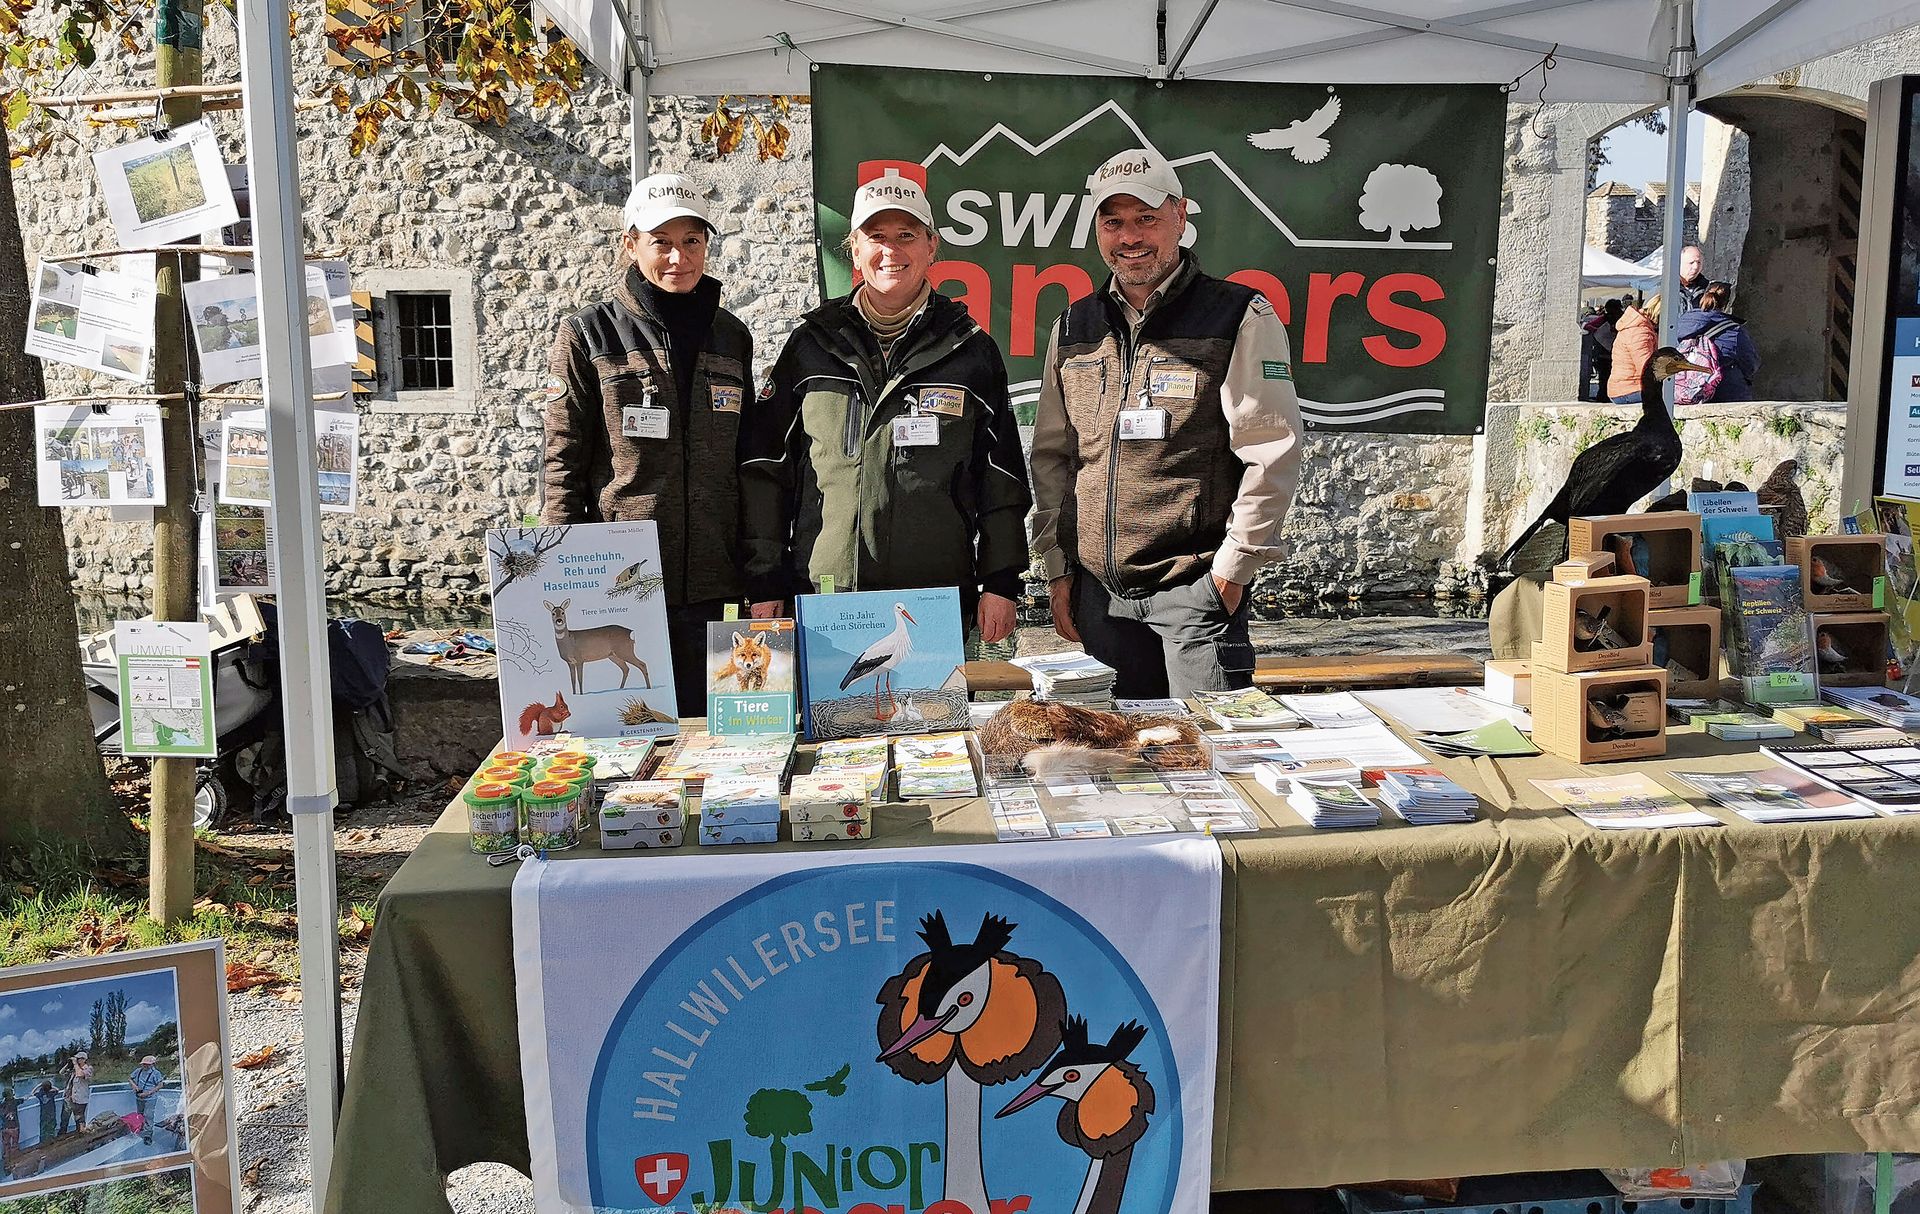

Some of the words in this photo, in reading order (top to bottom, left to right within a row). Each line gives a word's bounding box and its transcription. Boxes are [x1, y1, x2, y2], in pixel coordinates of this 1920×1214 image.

[1100, 158, 1150, 182] Ranger
[648, 186, 697, 201] Ranger
[865, 186, 917, 201] Ranger
[853, 260, 1447, 368] anrs
[1168, 383, 1194, 391] Ranger
[938, 399, 962, 409] Ranger
[1718, 505, 1748, 514] Schweiz
[627, 527, 645, 535] Müller
[557, 551, 626, 565] Schneehuhn,
[564, 566, 584, 577] Reh
[587, 564, 607, 576] und
[543, 579, 600, 592] Haselmaus
[1742, 600, 1772, 609] Reptilien
[581, 608, 598, 616] Tiere
[599, 607, 607, 615] im
[608, 606, 629, 614] Winter
[839, 612, 855, 621] Ein
[856, 611, 876, 620] Jahr
[1742, 608, 1755, 616] der
[1755, 607, 1782, 616] Schweiz
[814, 623, 830, 632] mit
[830, 622, 847, 631] den
[848, 620, 886, 630] Störchen
[130, 644, 184, 656] UMWELT
[1597, 651, 1620, 660] DecoBird
[734, 700, 769, 713] Tiere
[746, 714, 785, 726] Winter
[625, 726, 664, 735] GERSTENBERG
[1612, 741, 1637, 750] DecoBird
[633, 900, 896, 1122] HALLWILERSEE
